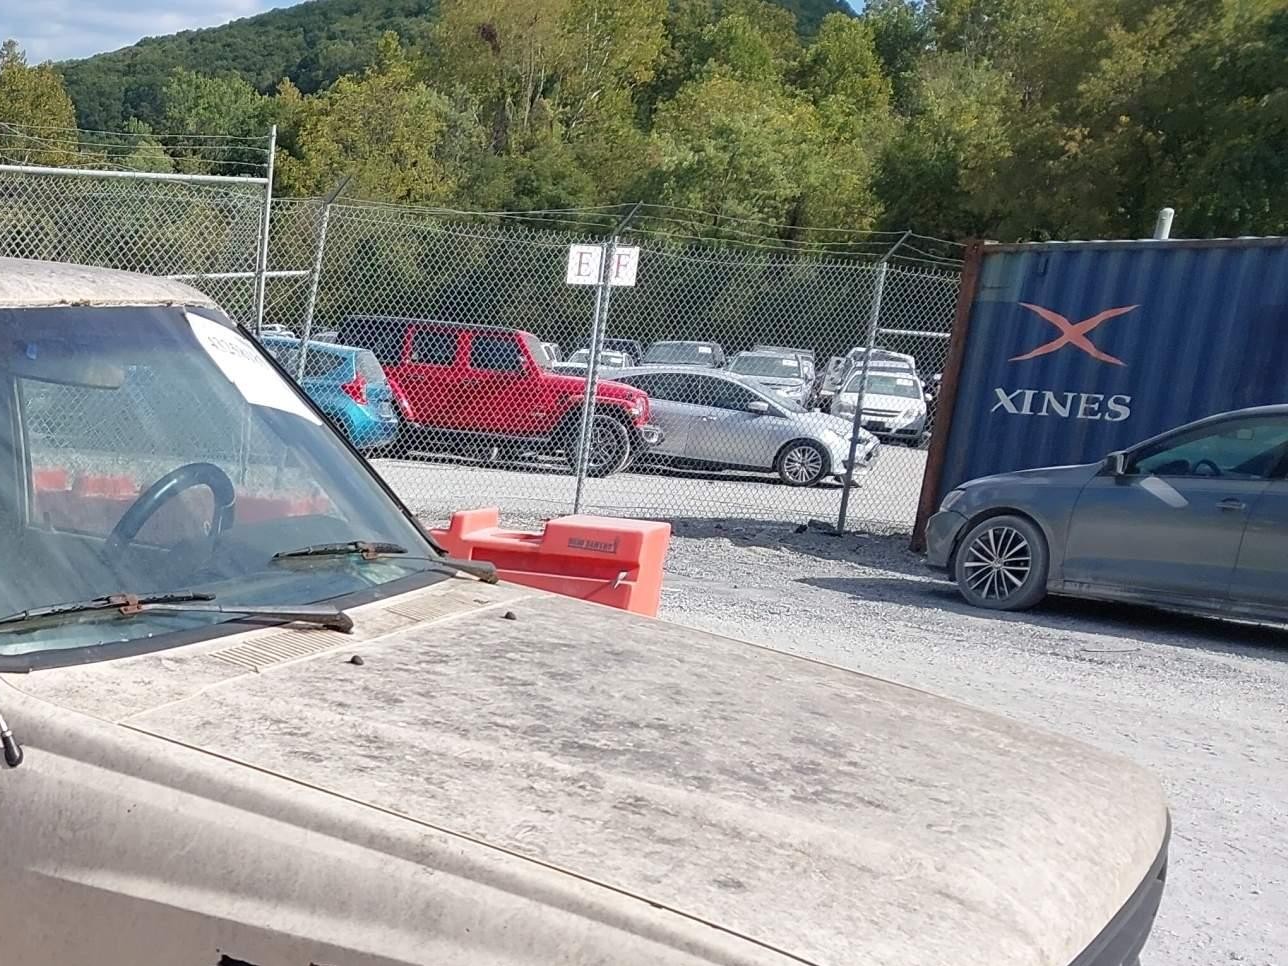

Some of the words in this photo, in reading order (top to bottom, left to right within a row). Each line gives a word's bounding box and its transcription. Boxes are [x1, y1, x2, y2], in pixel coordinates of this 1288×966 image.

[576, 251, 593, 277] E
[615, 252, 631, 278] F
[991, 387, 1132, 422] XINES
